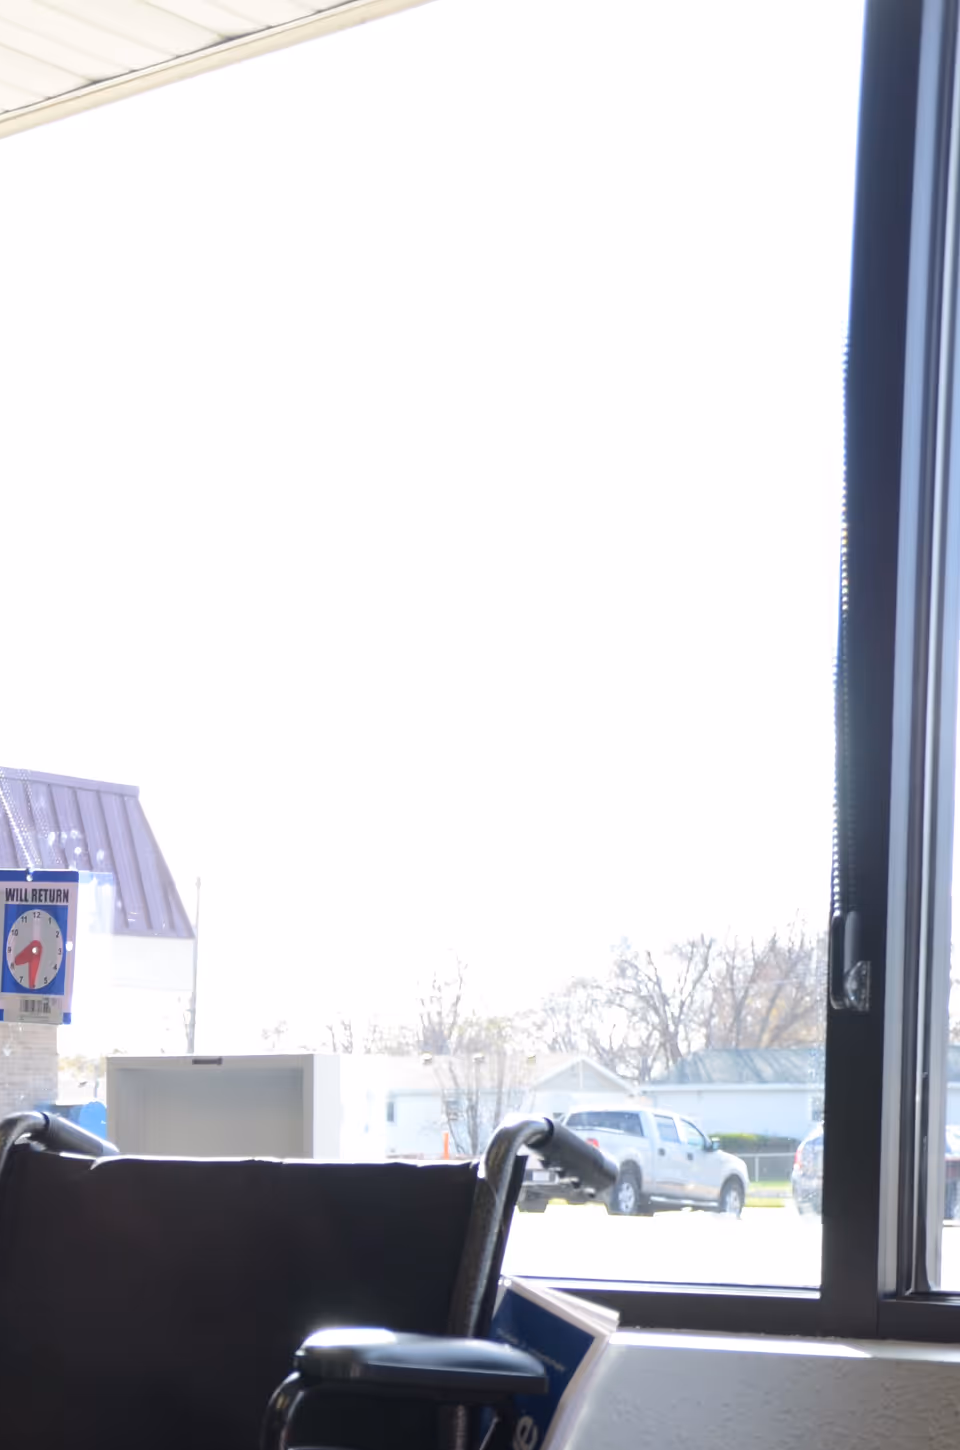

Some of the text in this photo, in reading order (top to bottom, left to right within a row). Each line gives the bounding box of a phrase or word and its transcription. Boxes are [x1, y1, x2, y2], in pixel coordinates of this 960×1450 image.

[5, 888, 69, 903] WILL RETURN
[21, 916, 28, 924] 11
